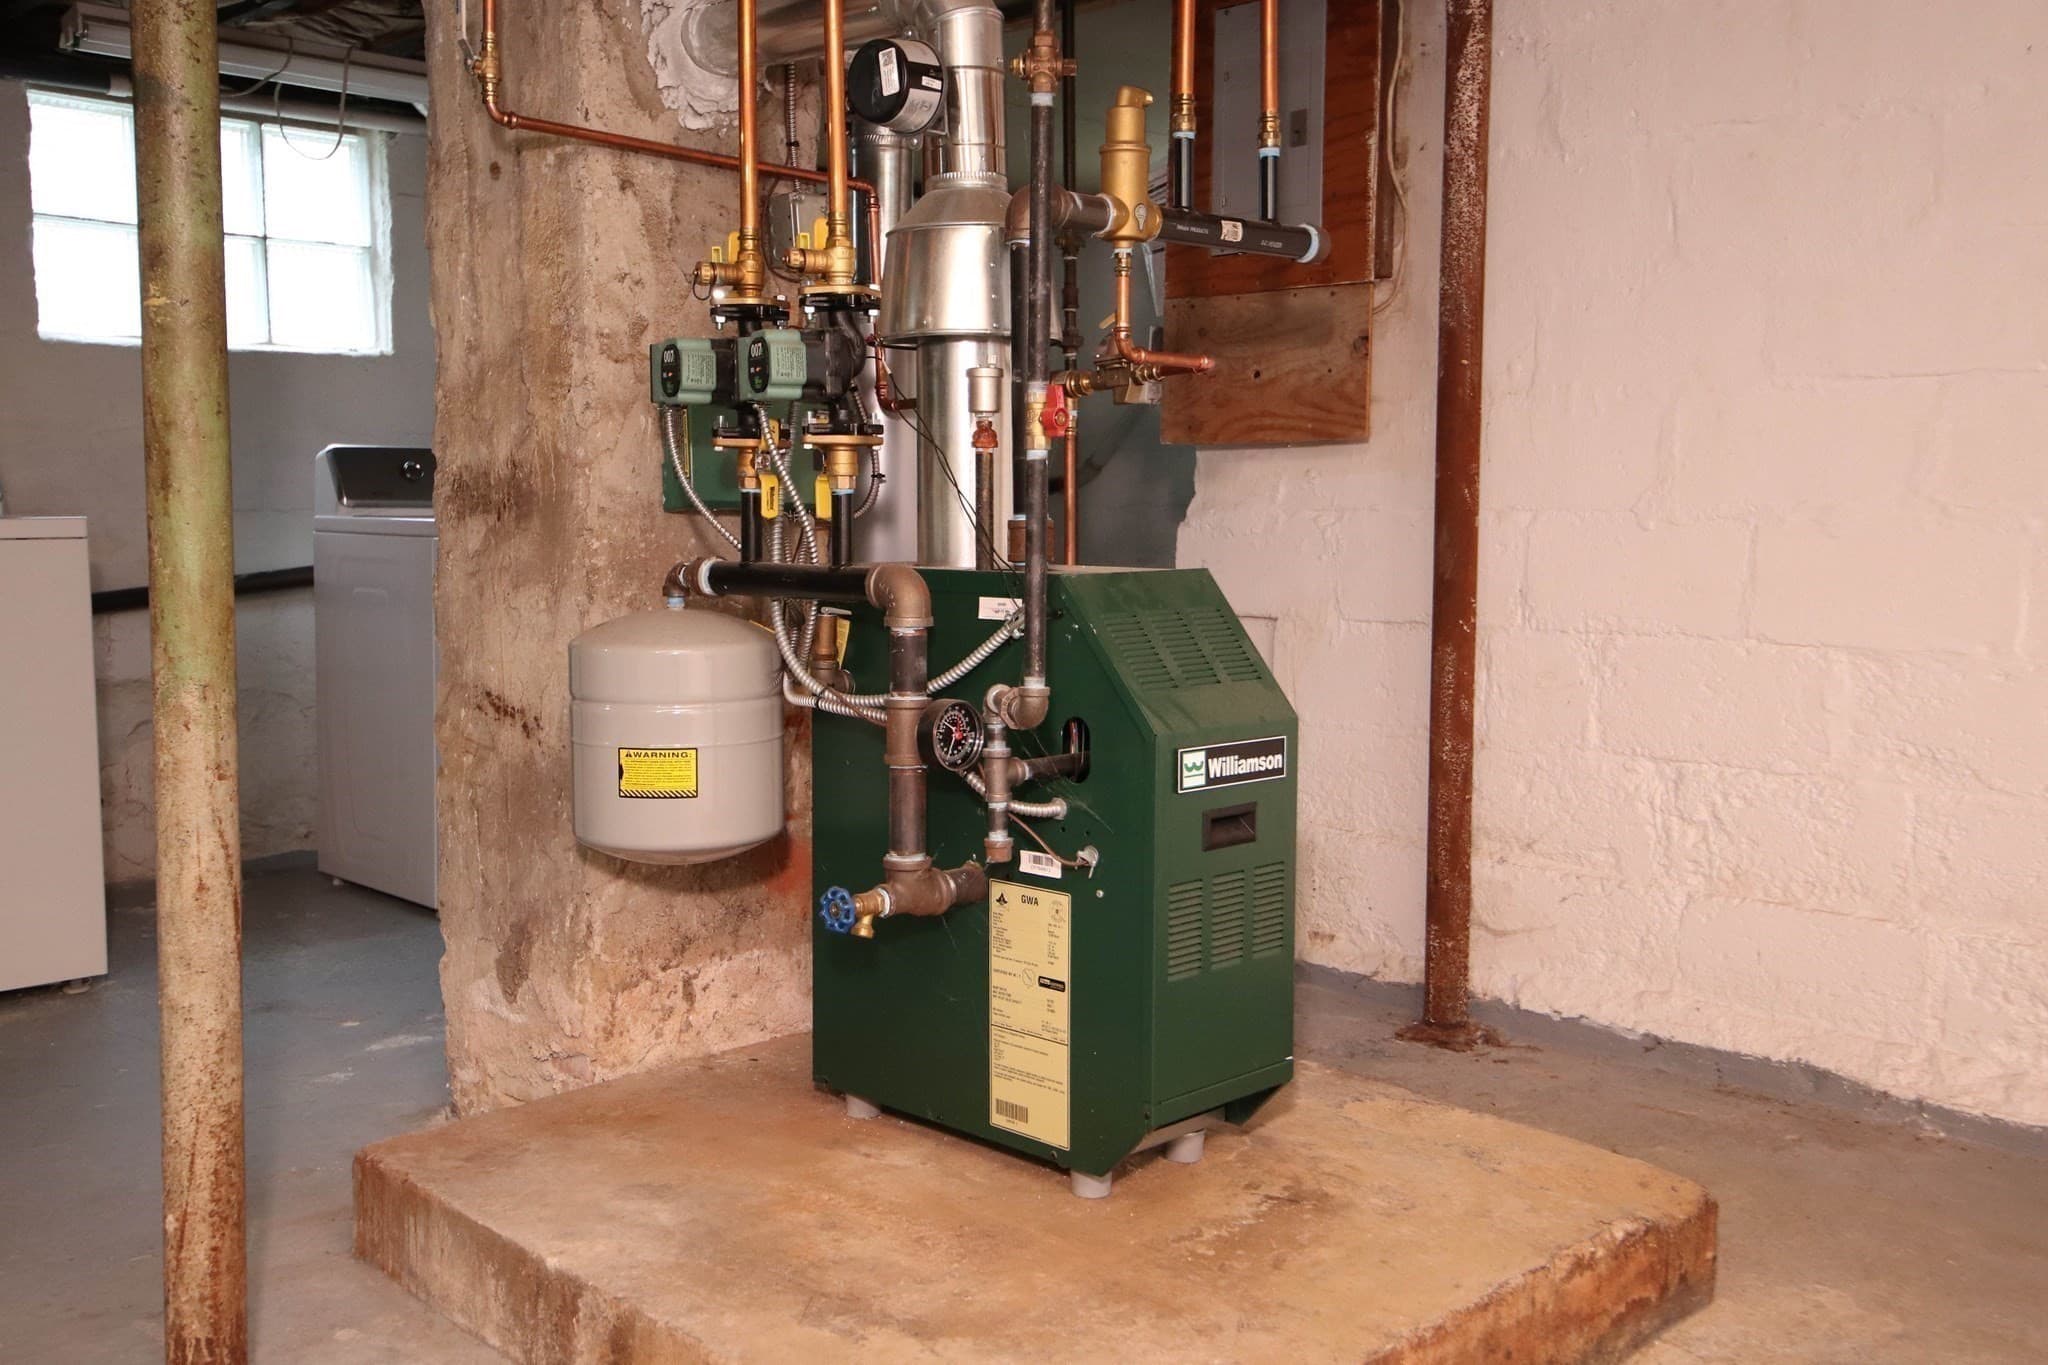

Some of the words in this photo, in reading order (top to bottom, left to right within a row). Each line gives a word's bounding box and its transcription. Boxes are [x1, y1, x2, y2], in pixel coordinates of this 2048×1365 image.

[664, 350, 674, 363] 007
[751, 342, 762, 357] 007
[1208, 753, 1282, 778] Williamson
[1021, 894, 1040, 907] GWA
